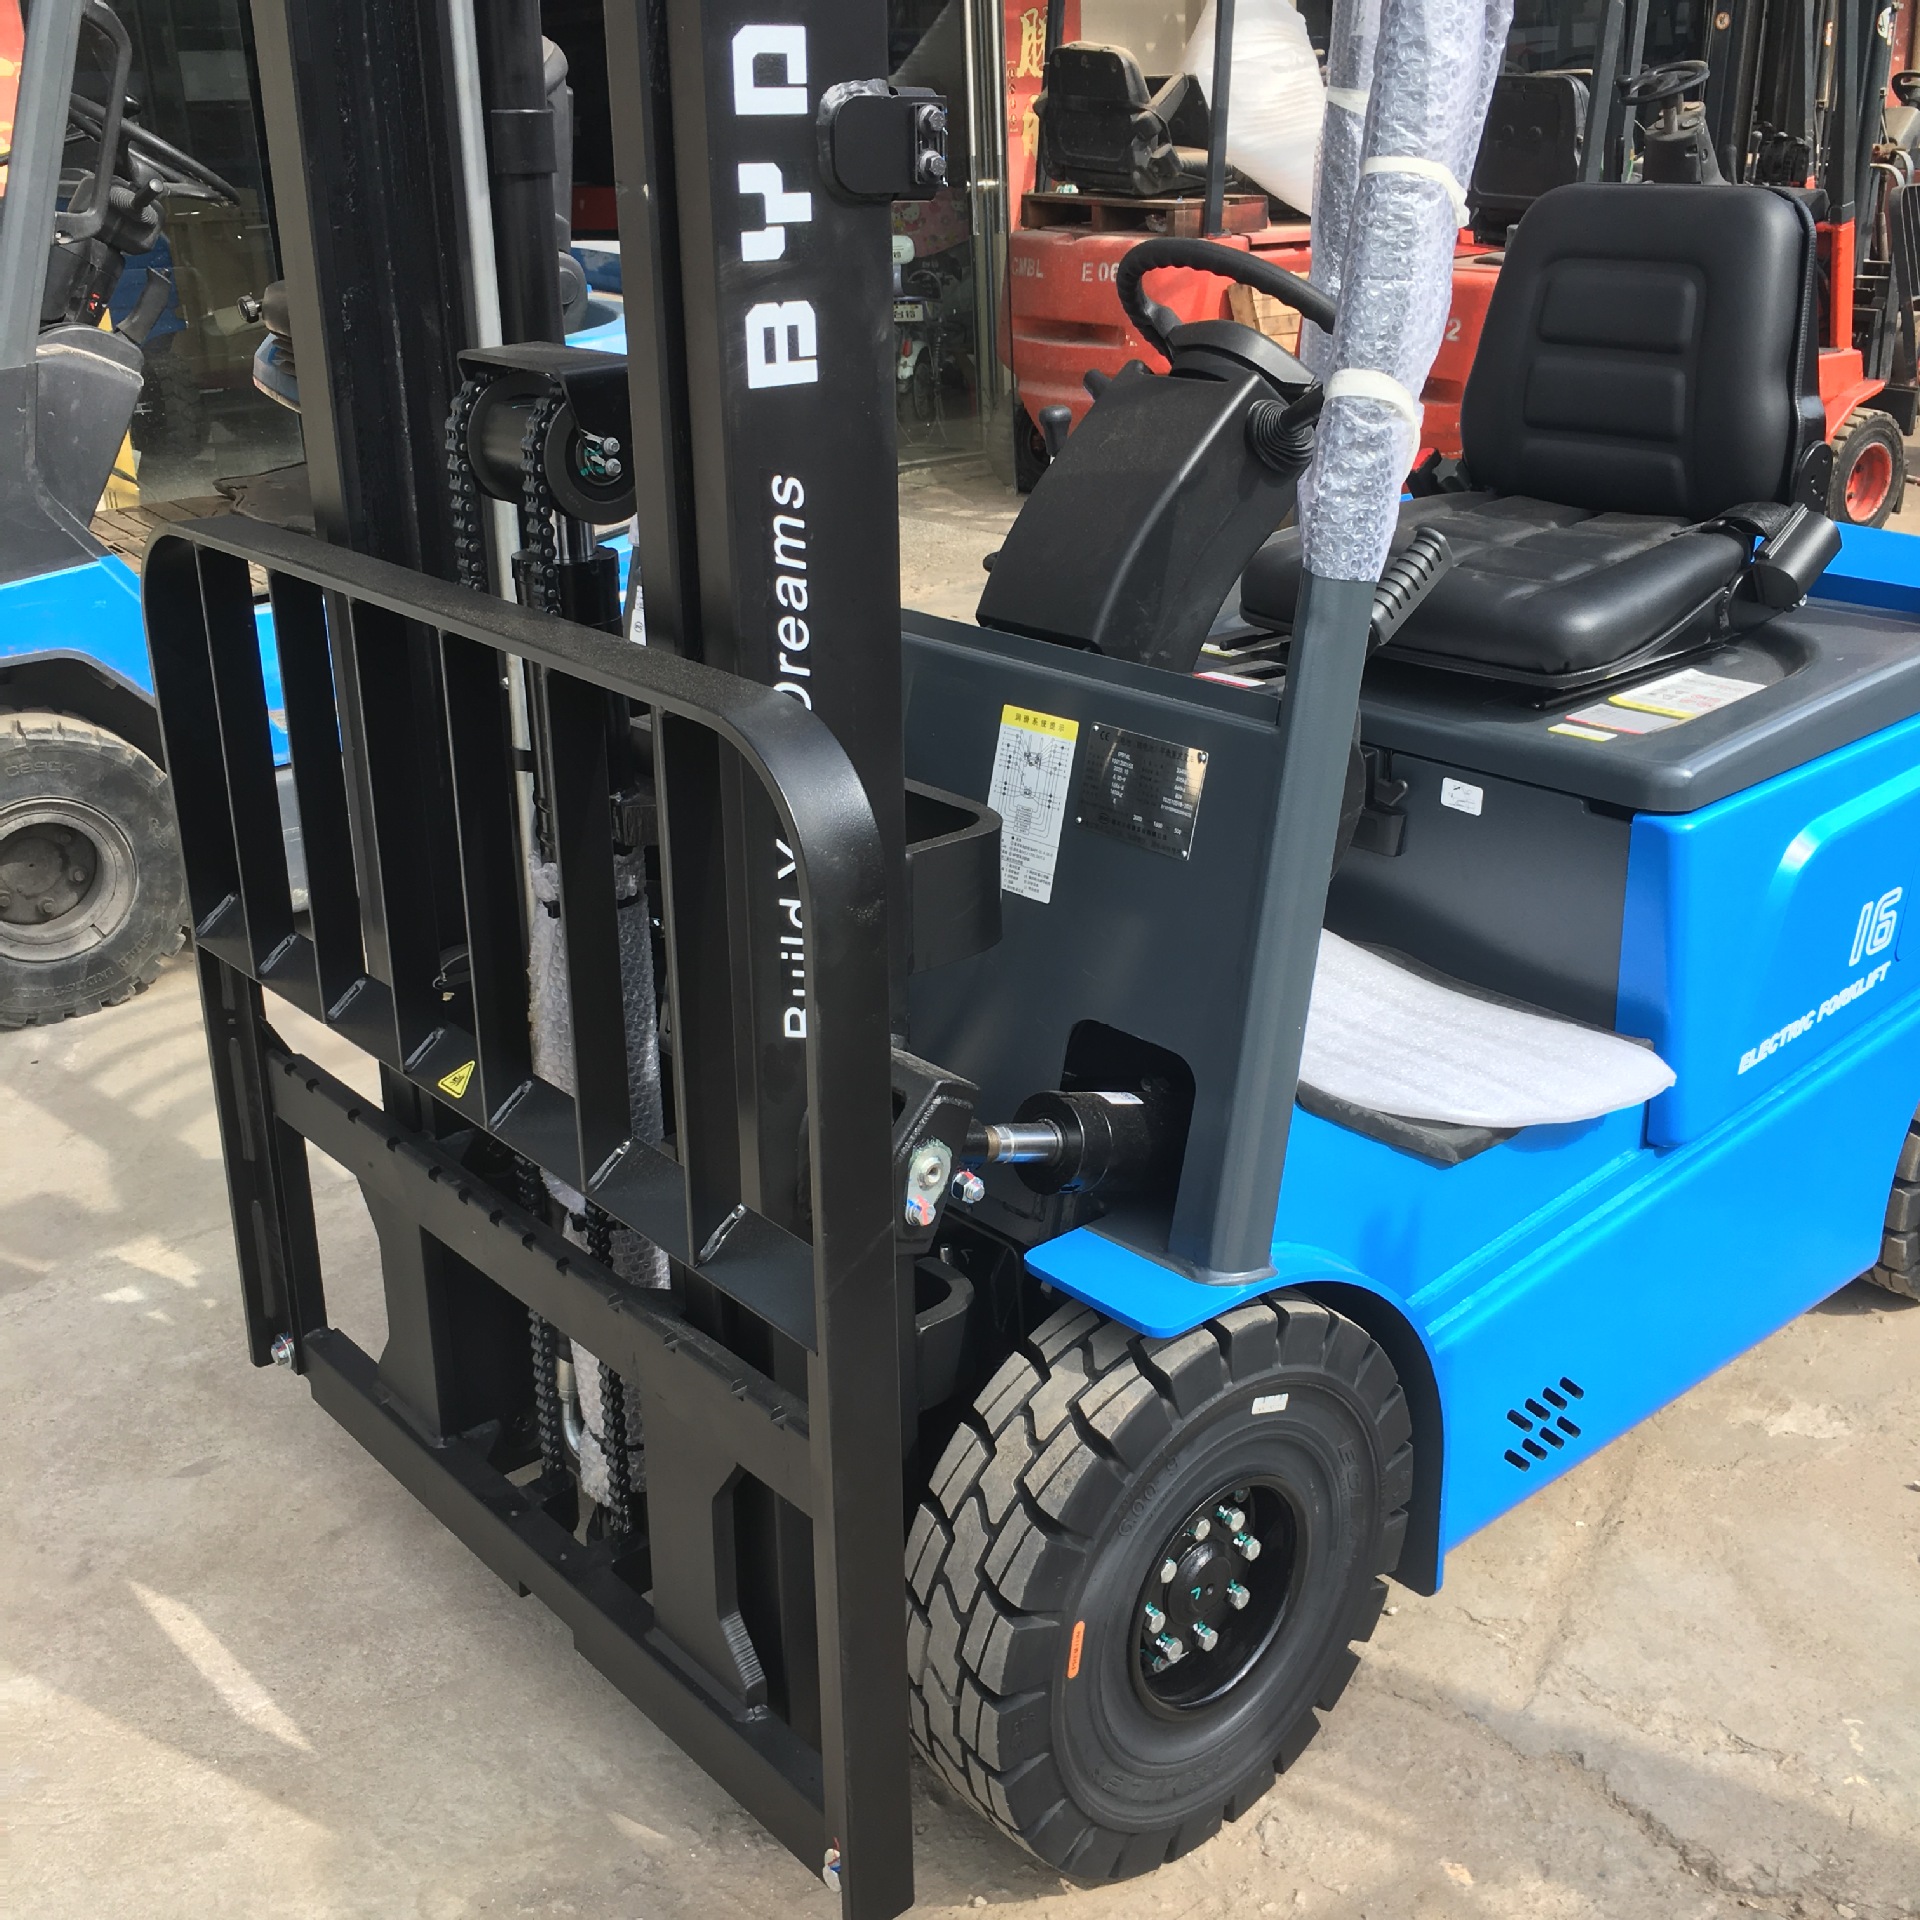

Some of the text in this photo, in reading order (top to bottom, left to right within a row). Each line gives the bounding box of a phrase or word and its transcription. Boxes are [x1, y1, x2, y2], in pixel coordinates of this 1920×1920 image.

[732, 24, 818, 389] BYD
[1081, 262, 1094, 282] E
[1848, 886, 1903, 967] 16
[1738, 960, 1892, 1076] ELECTRIC FORKLIFT
